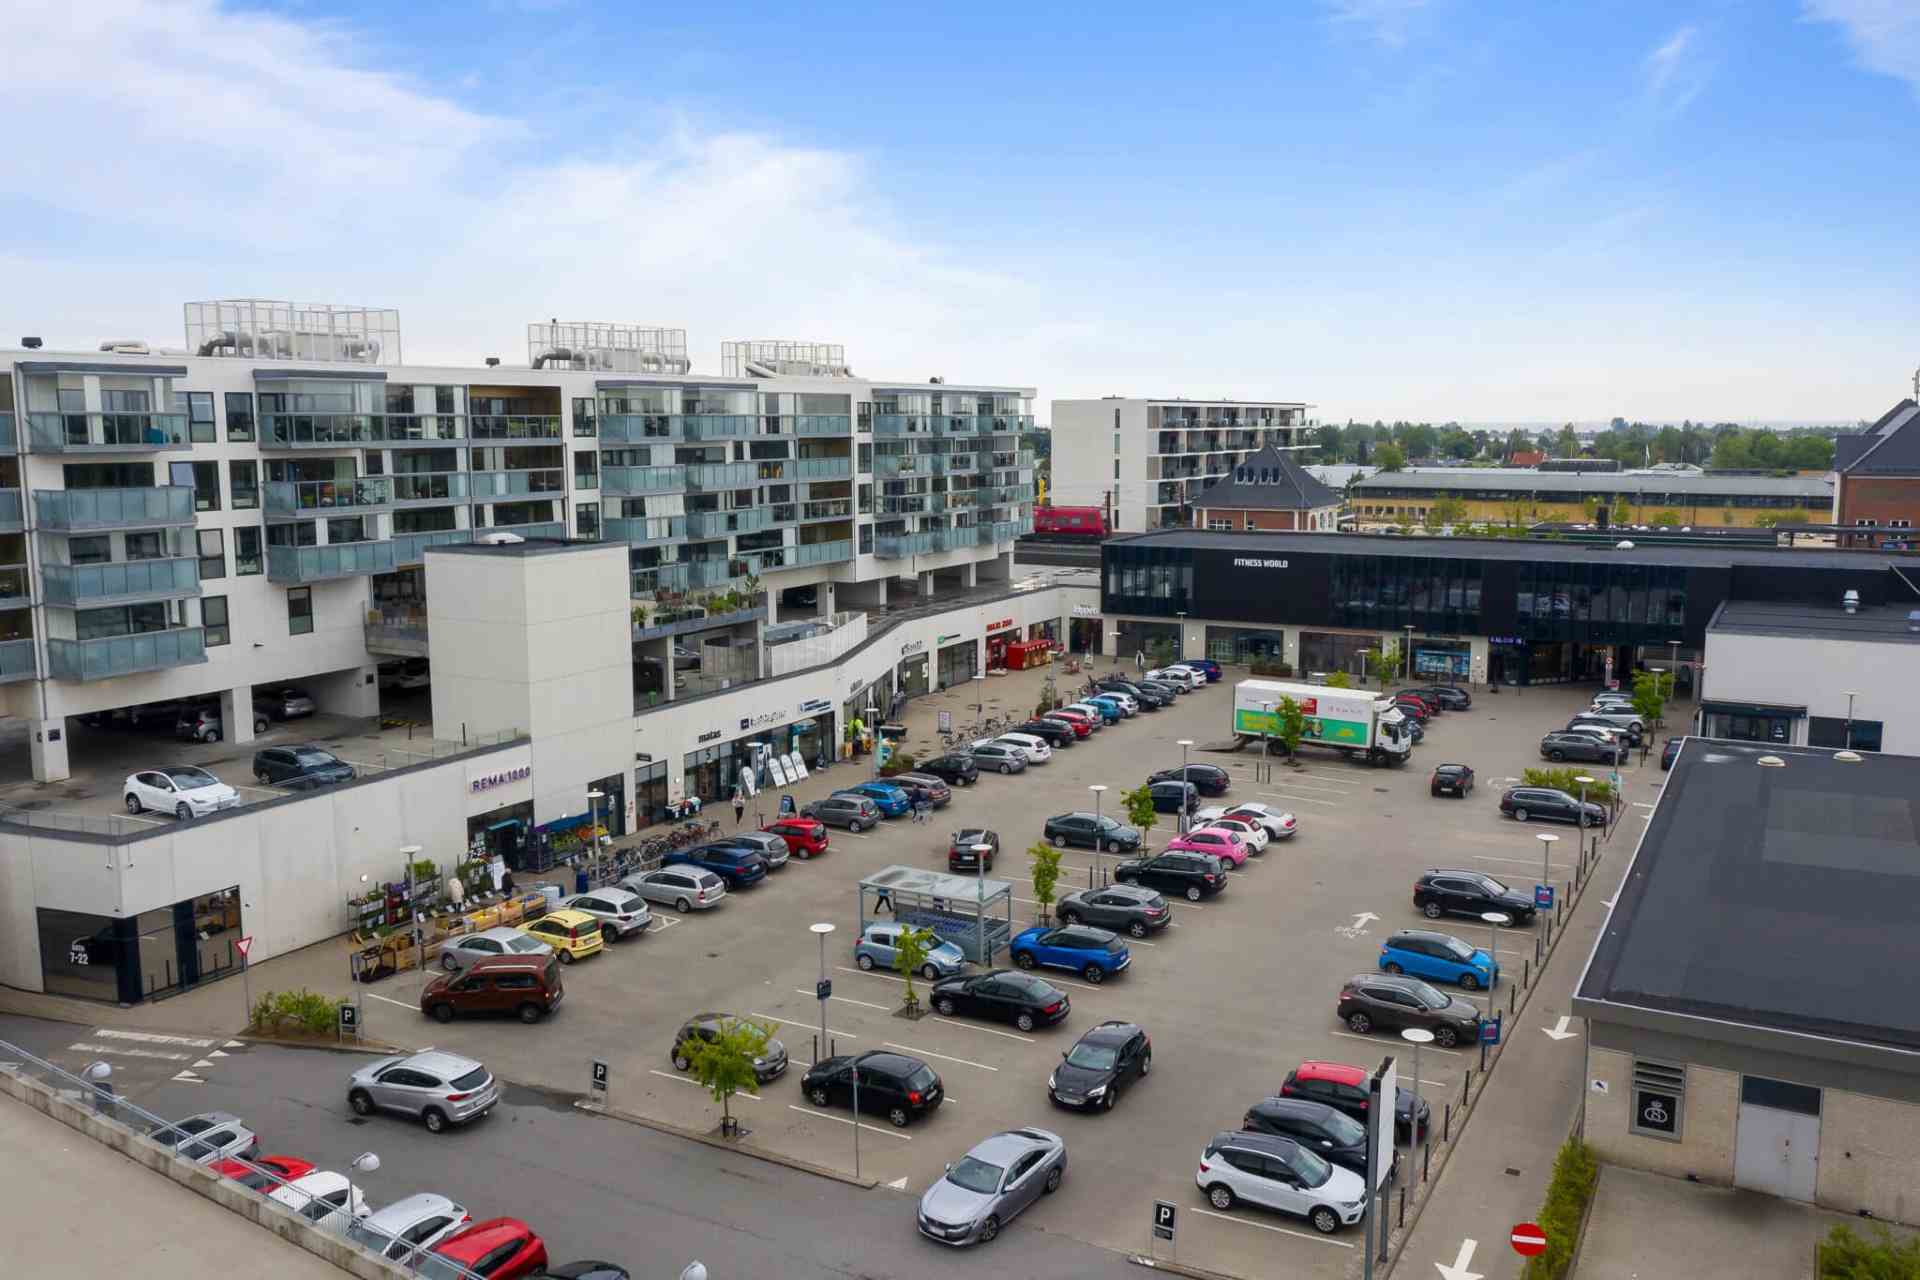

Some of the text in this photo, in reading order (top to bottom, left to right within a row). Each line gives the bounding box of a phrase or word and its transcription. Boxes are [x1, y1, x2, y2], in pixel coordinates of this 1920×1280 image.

[1233, 558, 1289, 568] FITNESS WORLD
[471, 766, 531, 793] REMA 1000
[344, 1009, 352, 1021] P
[597, 1064, 605, 1078] P
[1160, 1207, 1171, 1223] P
